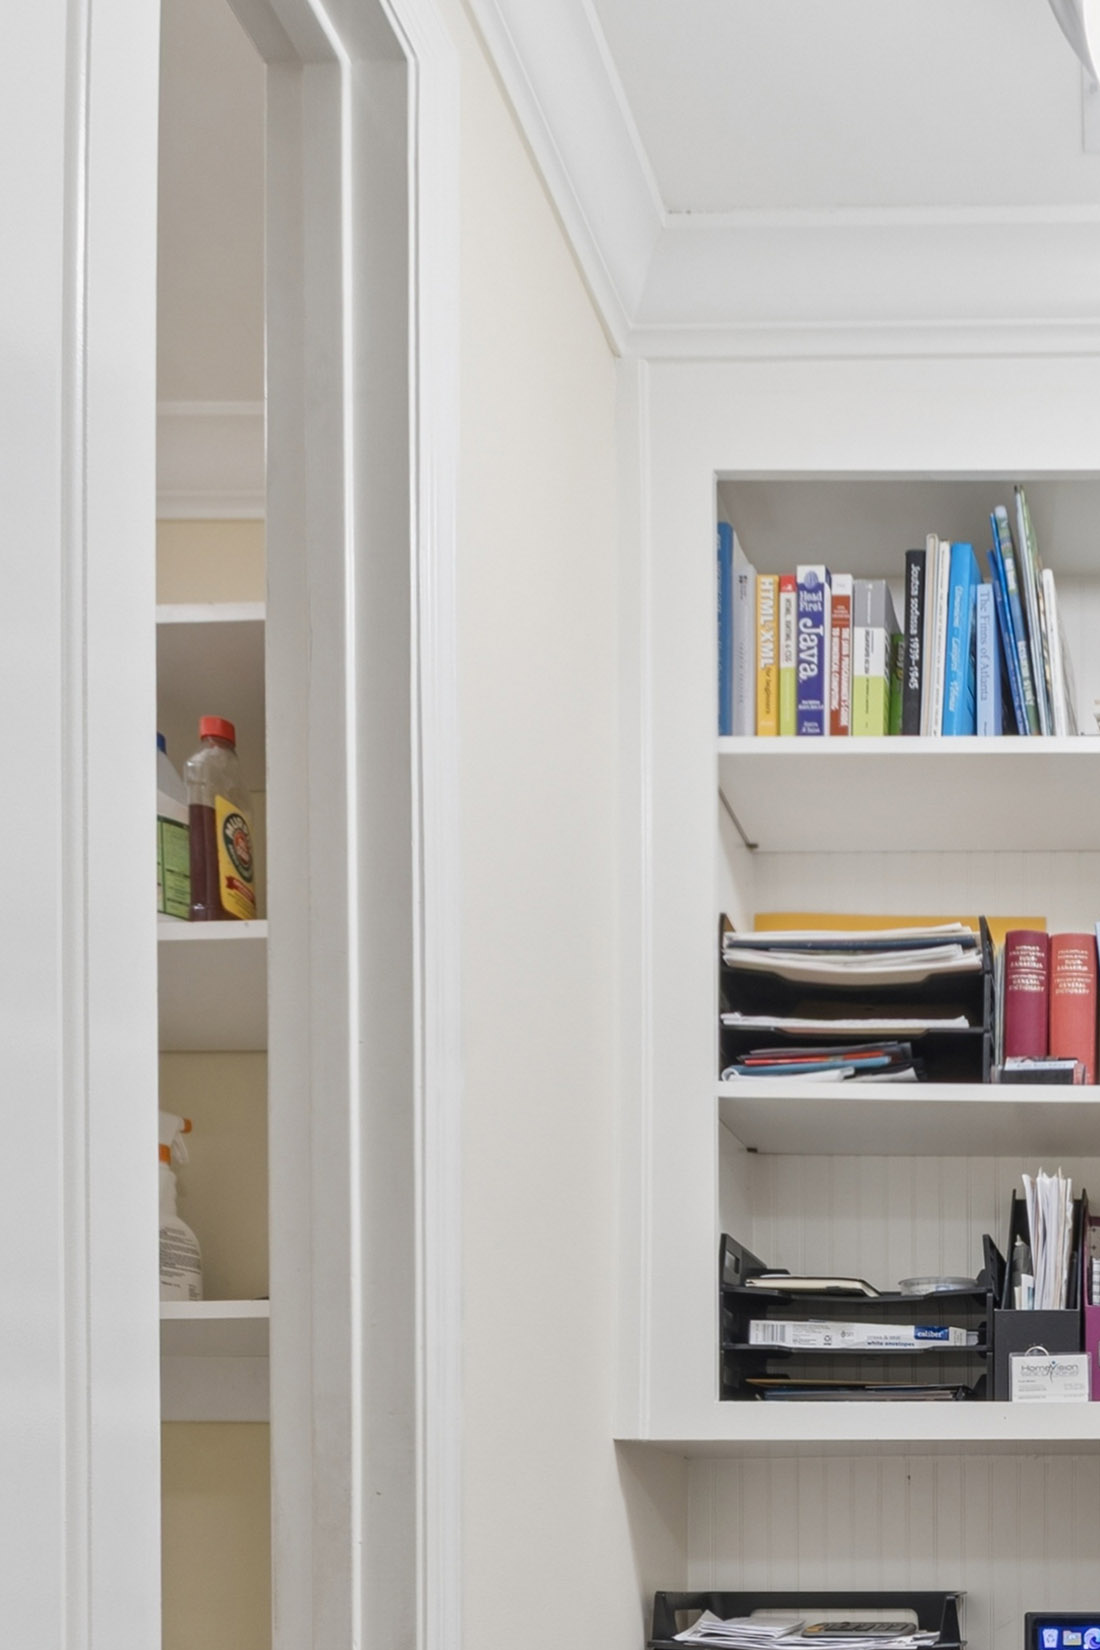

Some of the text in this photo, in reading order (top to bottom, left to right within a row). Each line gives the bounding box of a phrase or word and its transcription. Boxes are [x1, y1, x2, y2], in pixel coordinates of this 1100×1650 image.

[980, 591, 990, 701] The Finns of Atlanta
